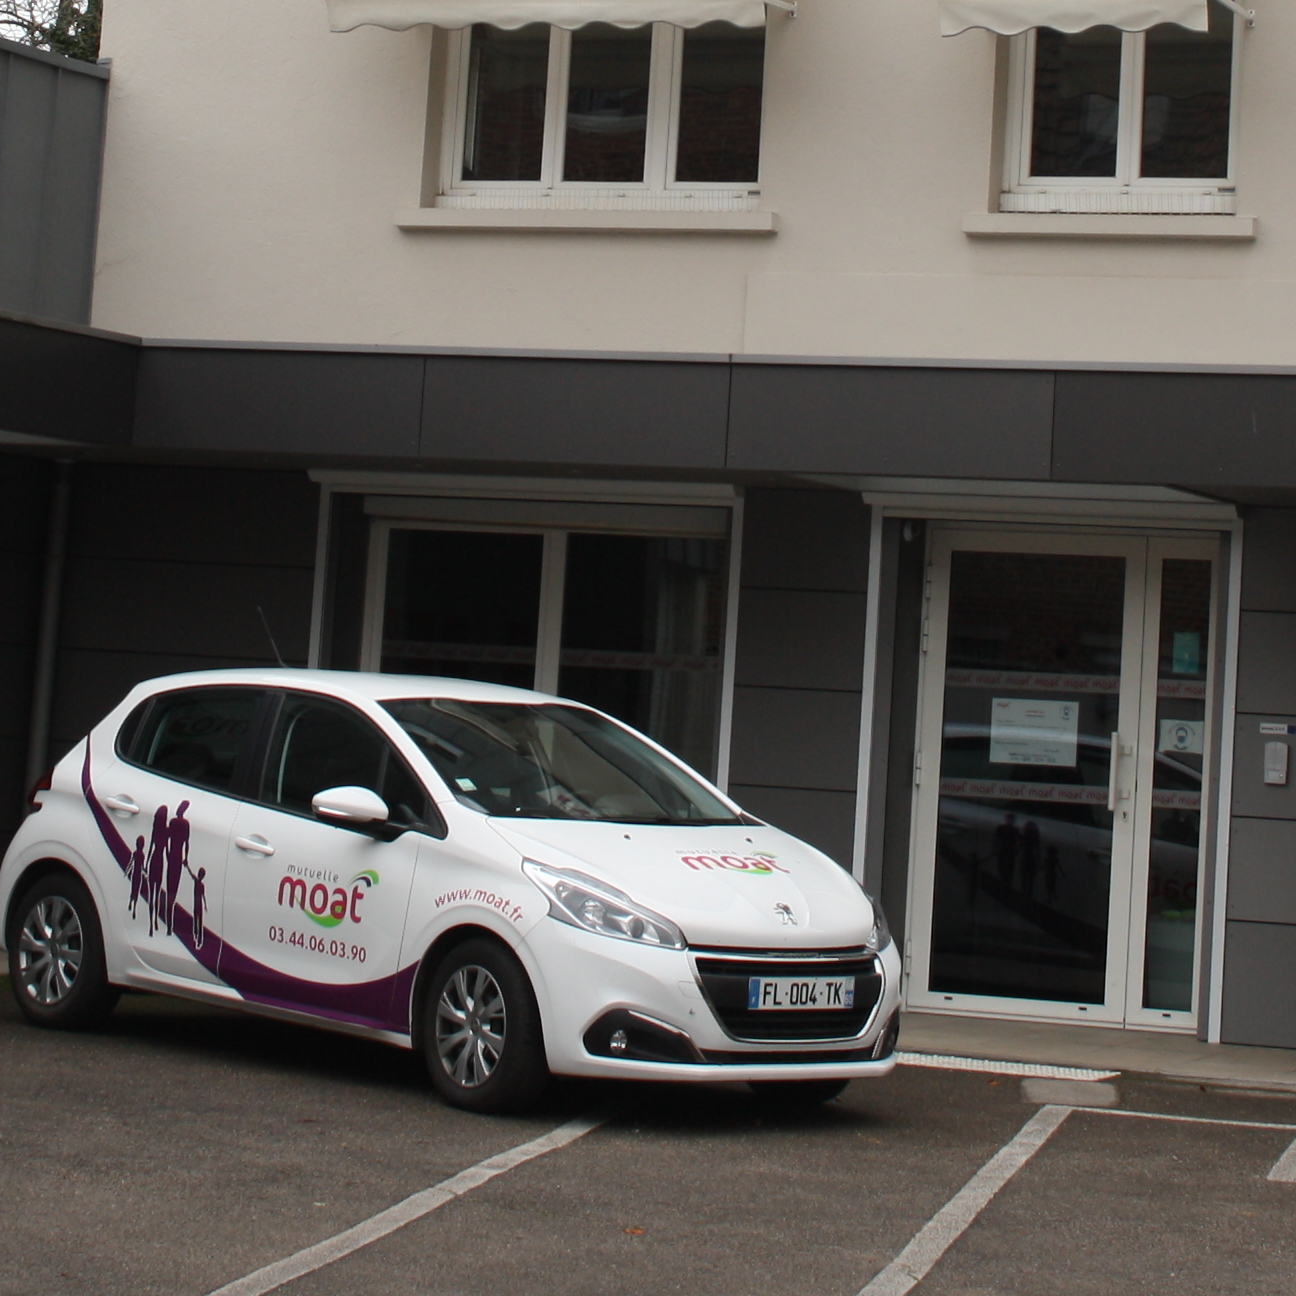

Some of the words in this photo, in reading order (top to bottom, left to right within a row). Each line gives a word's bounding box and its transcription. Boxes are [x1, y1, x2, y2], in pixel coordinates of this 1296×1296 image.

[1086, 790, 1108, 801] moa
[287, 864, 339, 883] mutuelle
[681, 855, 790, 874] moat
[278, 876, 364, 924] moat
[434, 888, 525, 923] www.moat.fr
[269, 925, 367, 963] 03.44.06.03.90
